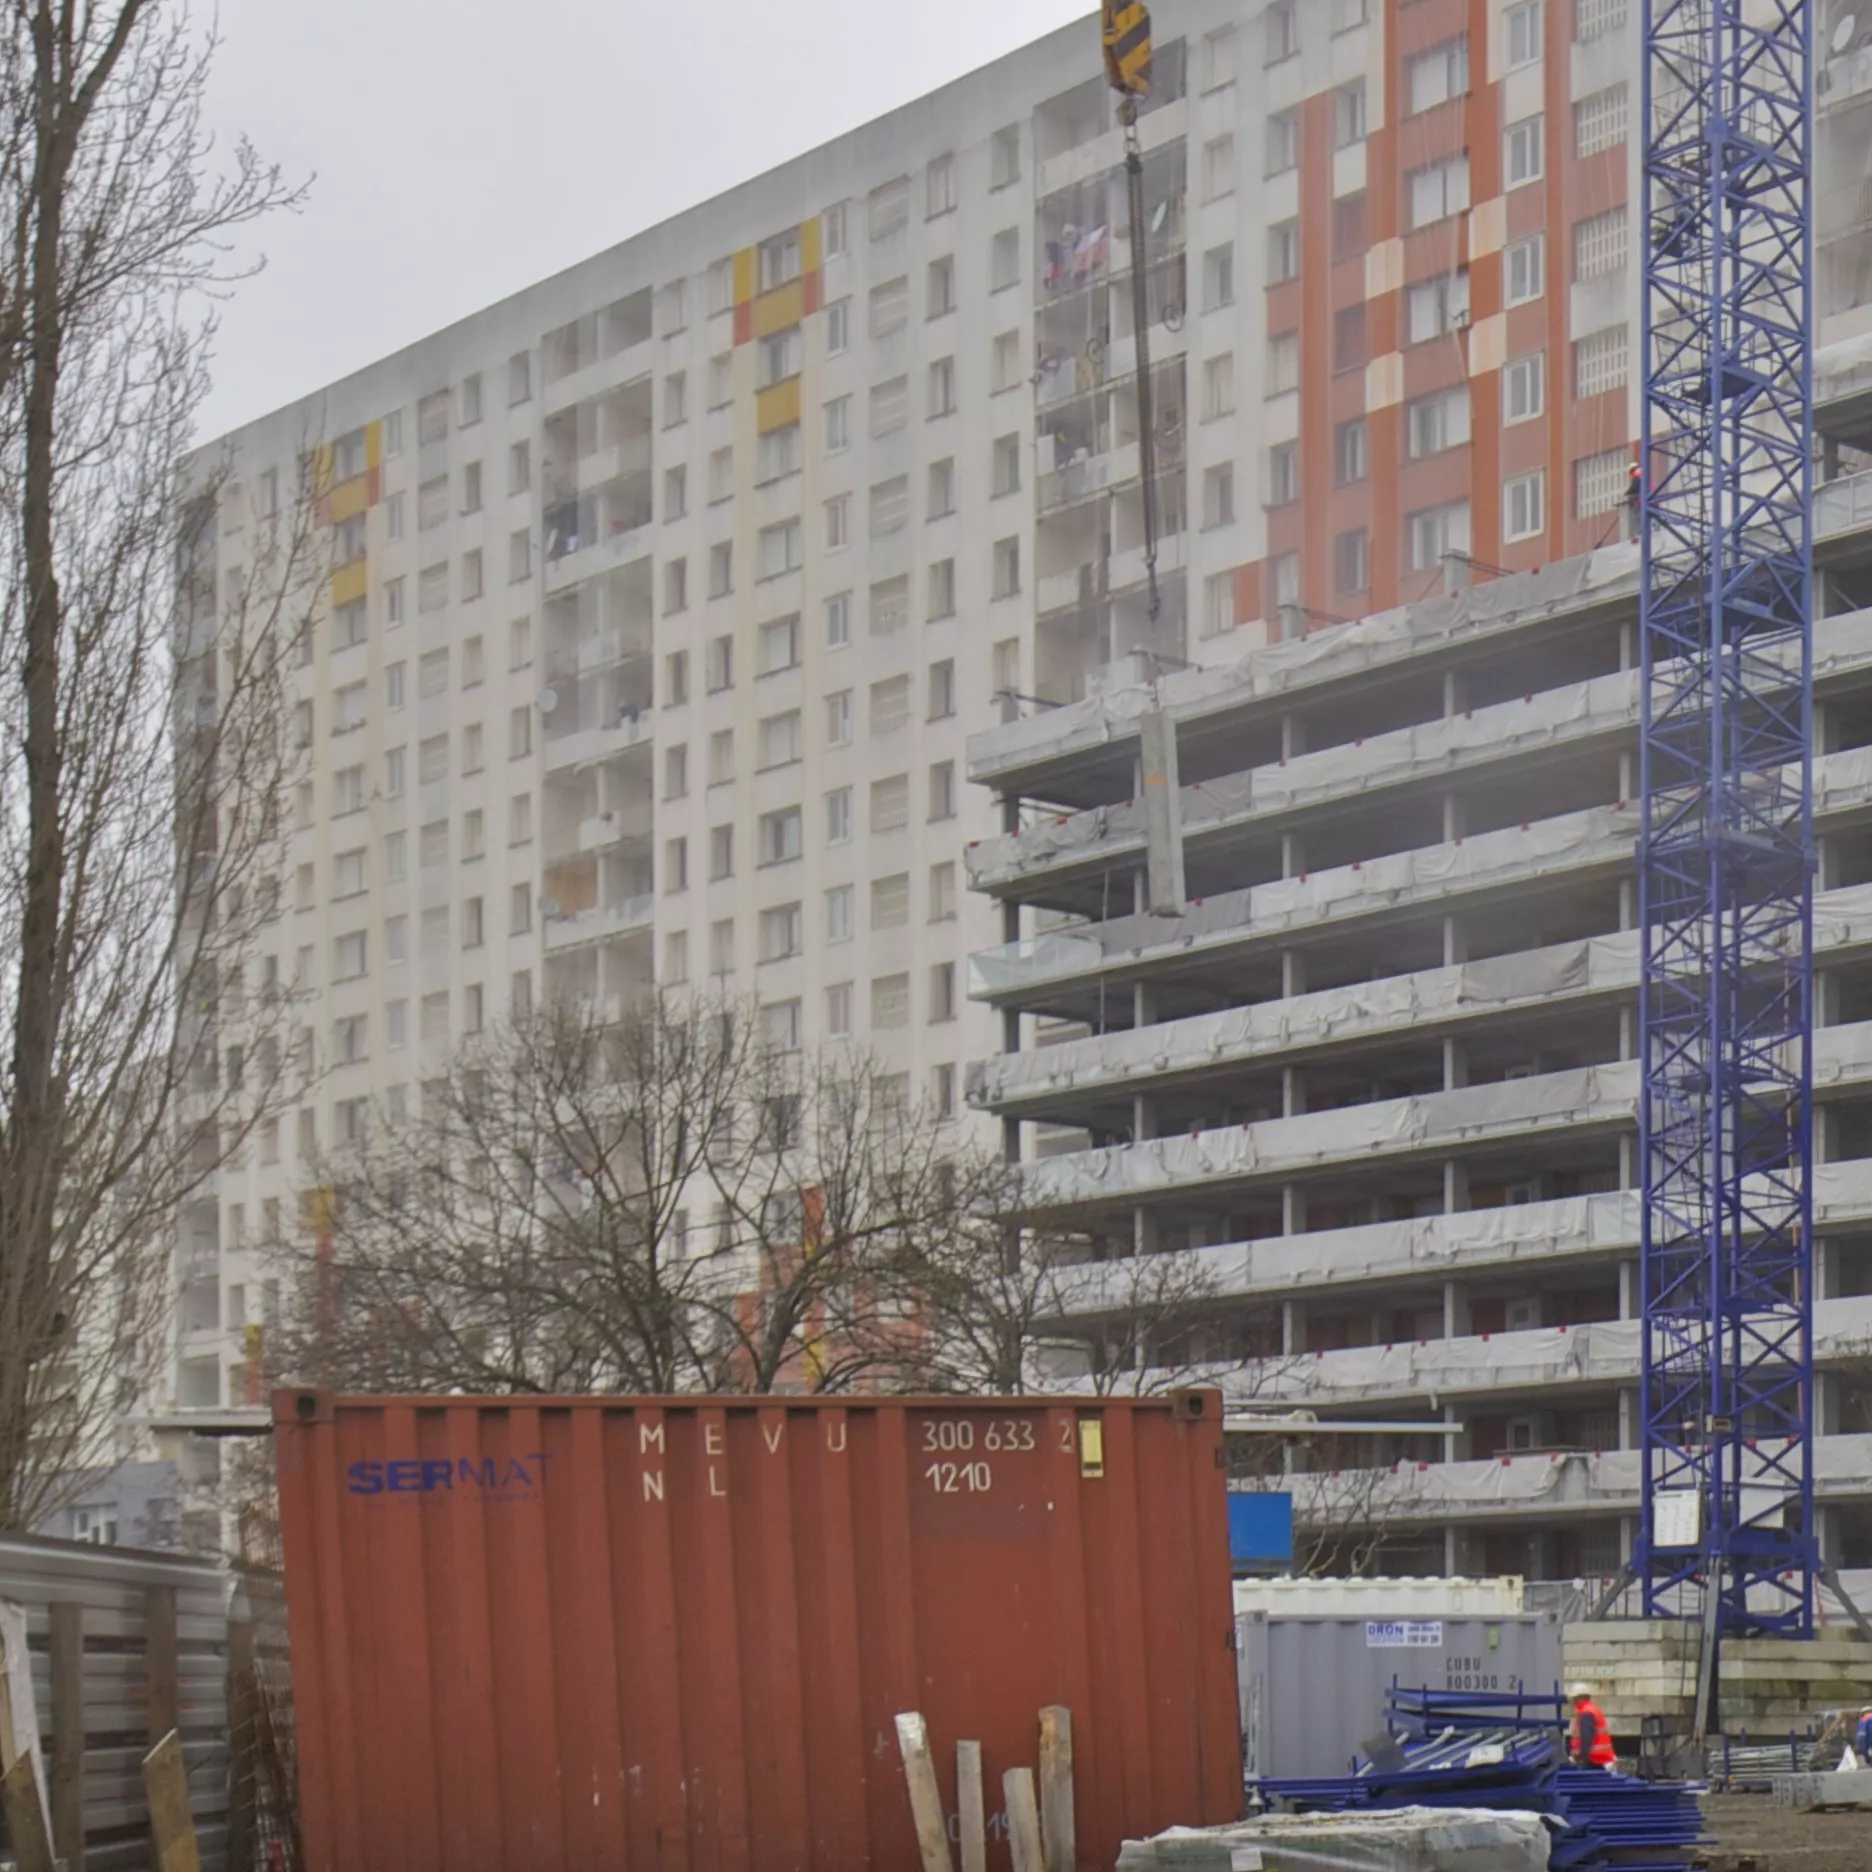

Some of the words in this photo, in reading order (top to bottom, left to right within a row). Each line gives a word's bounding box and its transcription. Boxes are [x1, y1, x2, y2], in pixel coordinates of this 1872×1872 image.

[922, 1420, 974, 1452] 300
[984, 1420, 1035, 1452] 633
[347, 1453, 553, 1496] SERMAT
[925, 1461, 992, 1493] 1210
